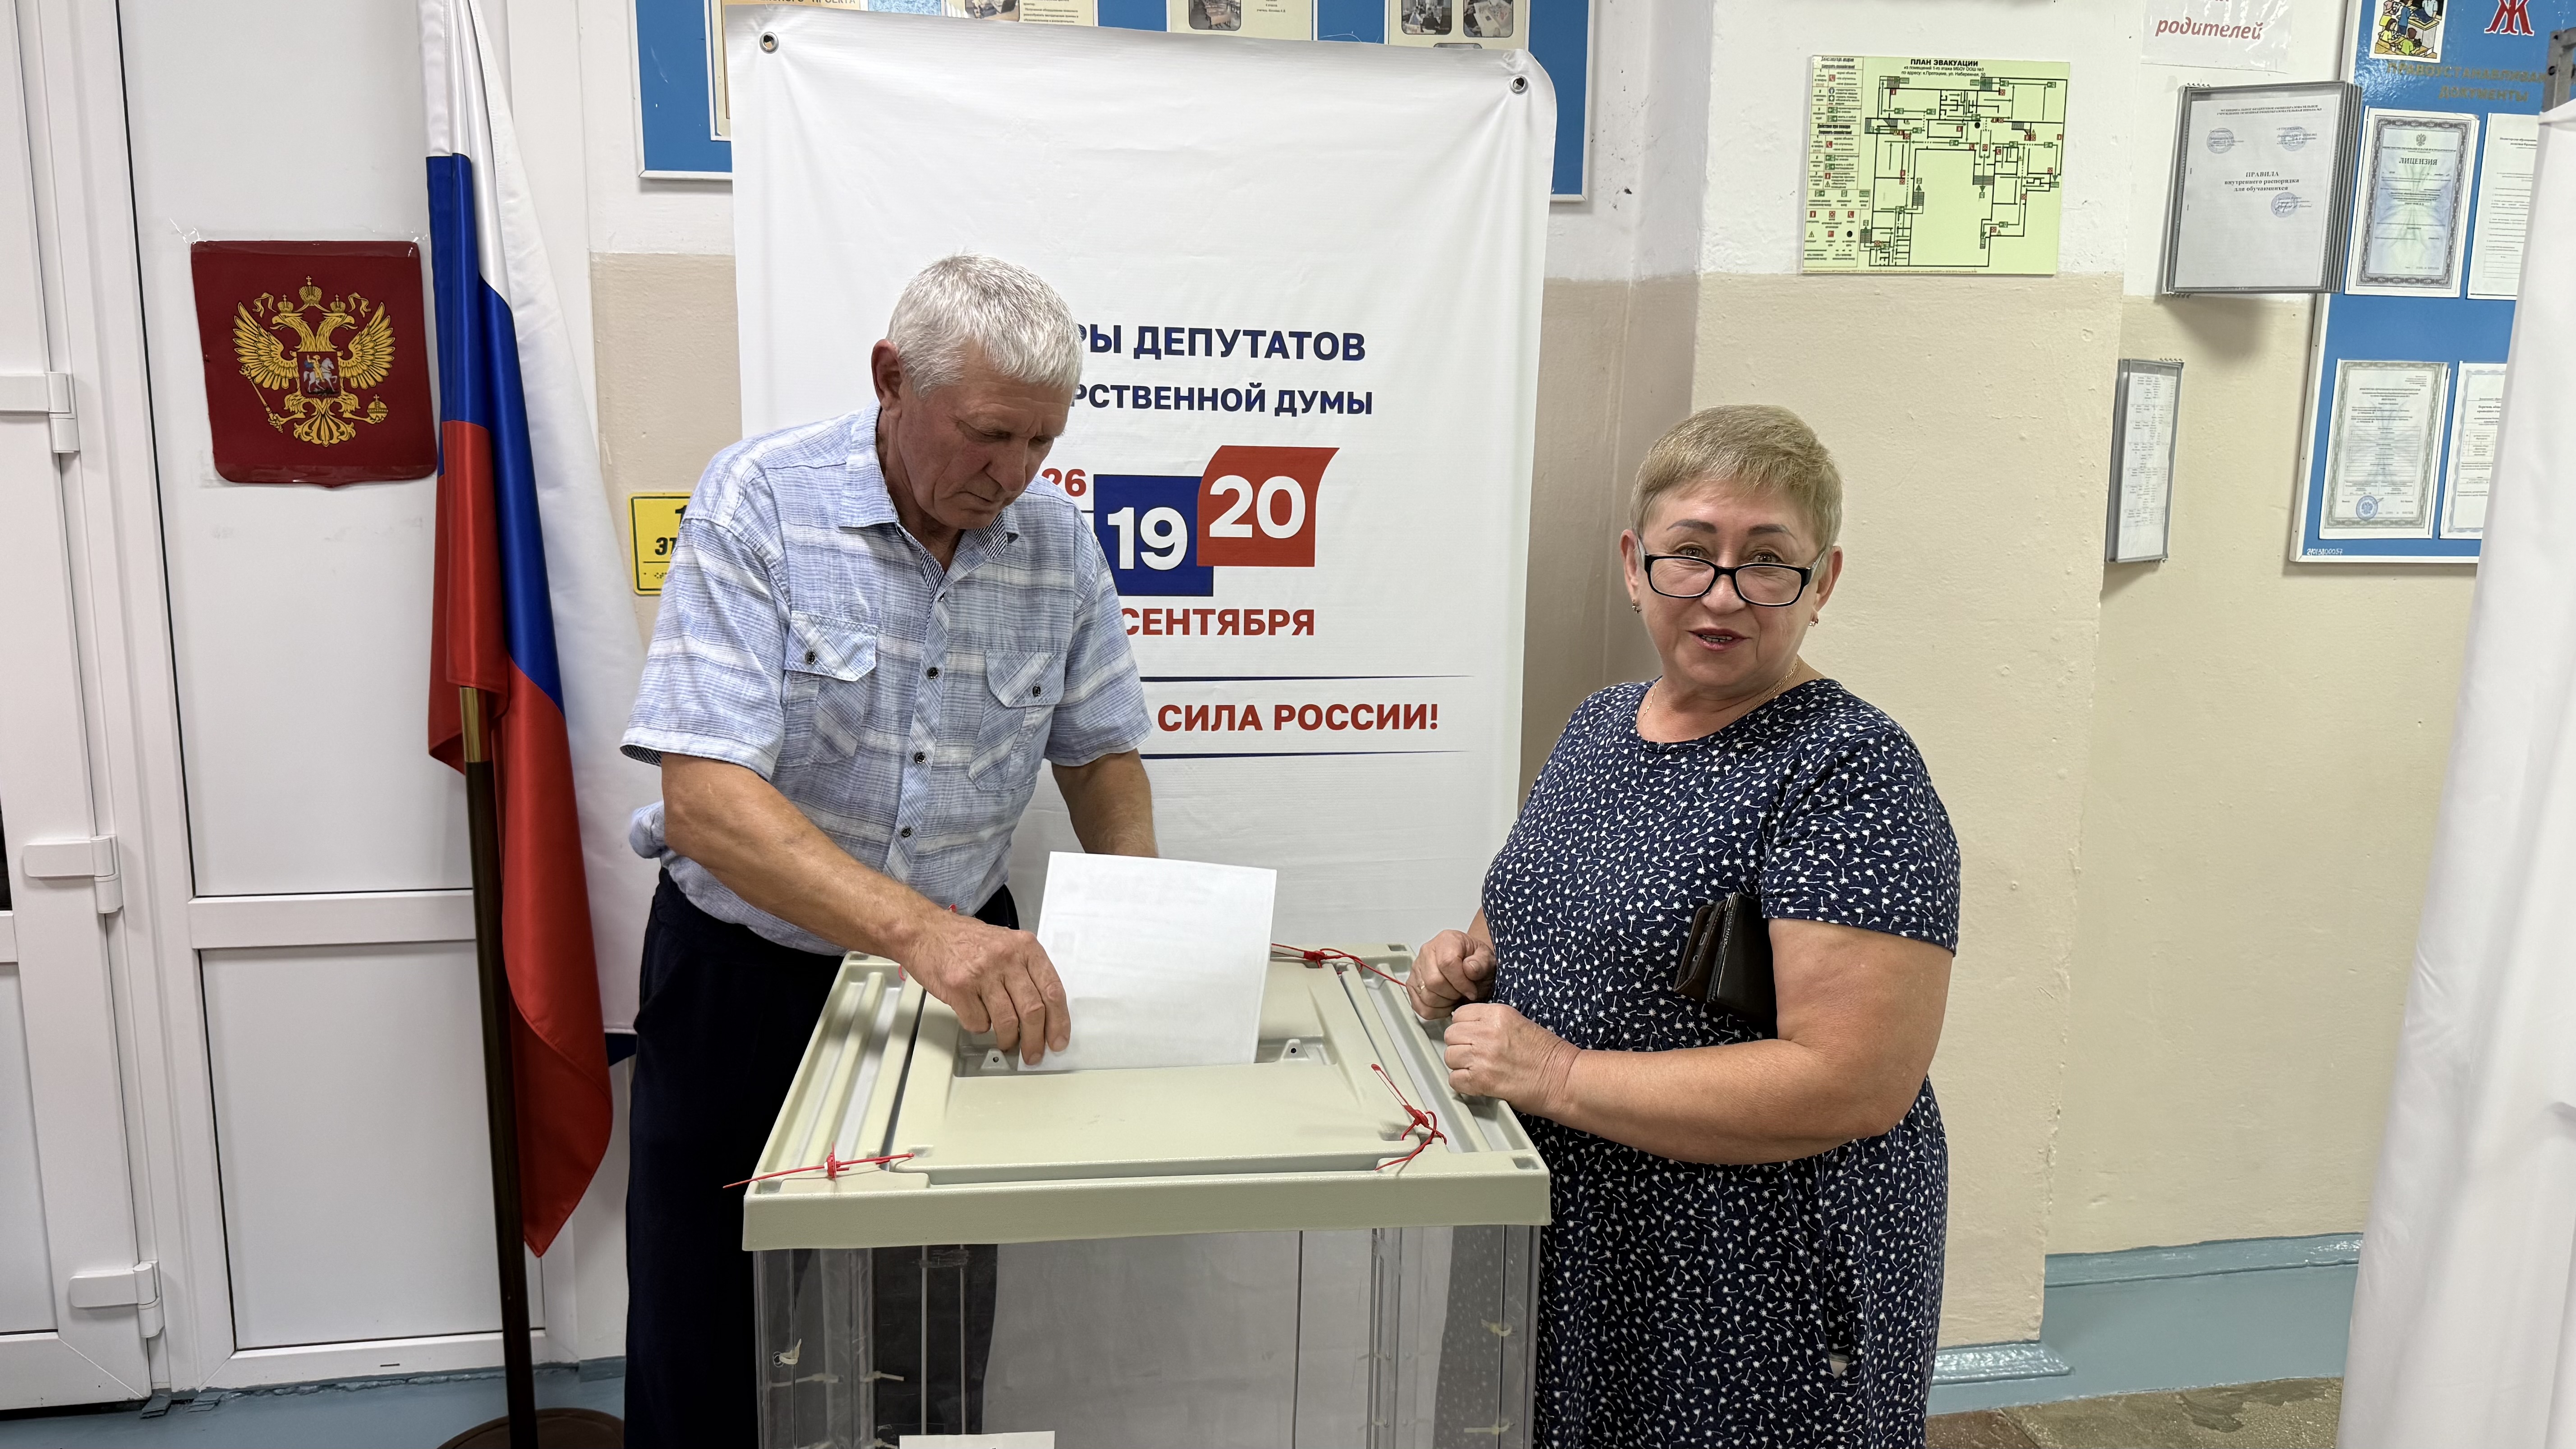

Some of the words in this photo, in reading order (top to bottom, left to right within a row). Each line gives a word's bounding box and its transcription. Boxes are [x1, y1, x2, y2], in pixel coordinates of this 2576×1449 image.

[2155, 17, 2263, 40] родителей
[2438, 85, 2529, 101] ДОКУМЕНТЫ
[1133, 326, 1366, 361] ДЕПУТАТОВ
[1074, 382, 1265, 413] РСТВЕННОЙ
[1274, 390, 1372, 417] ДУМЫ
[1042, 468, 1086, 497] 26
[1210, 475, 1306, 539] 20
[1107, 507, 1188, 570] 19
[1121, 607, 1315, 636] СЕНТЯБРЯ
[1158, 704, 1263, 731] СИЛА
[1274, 704, 1438, 731] РОССИИ!
